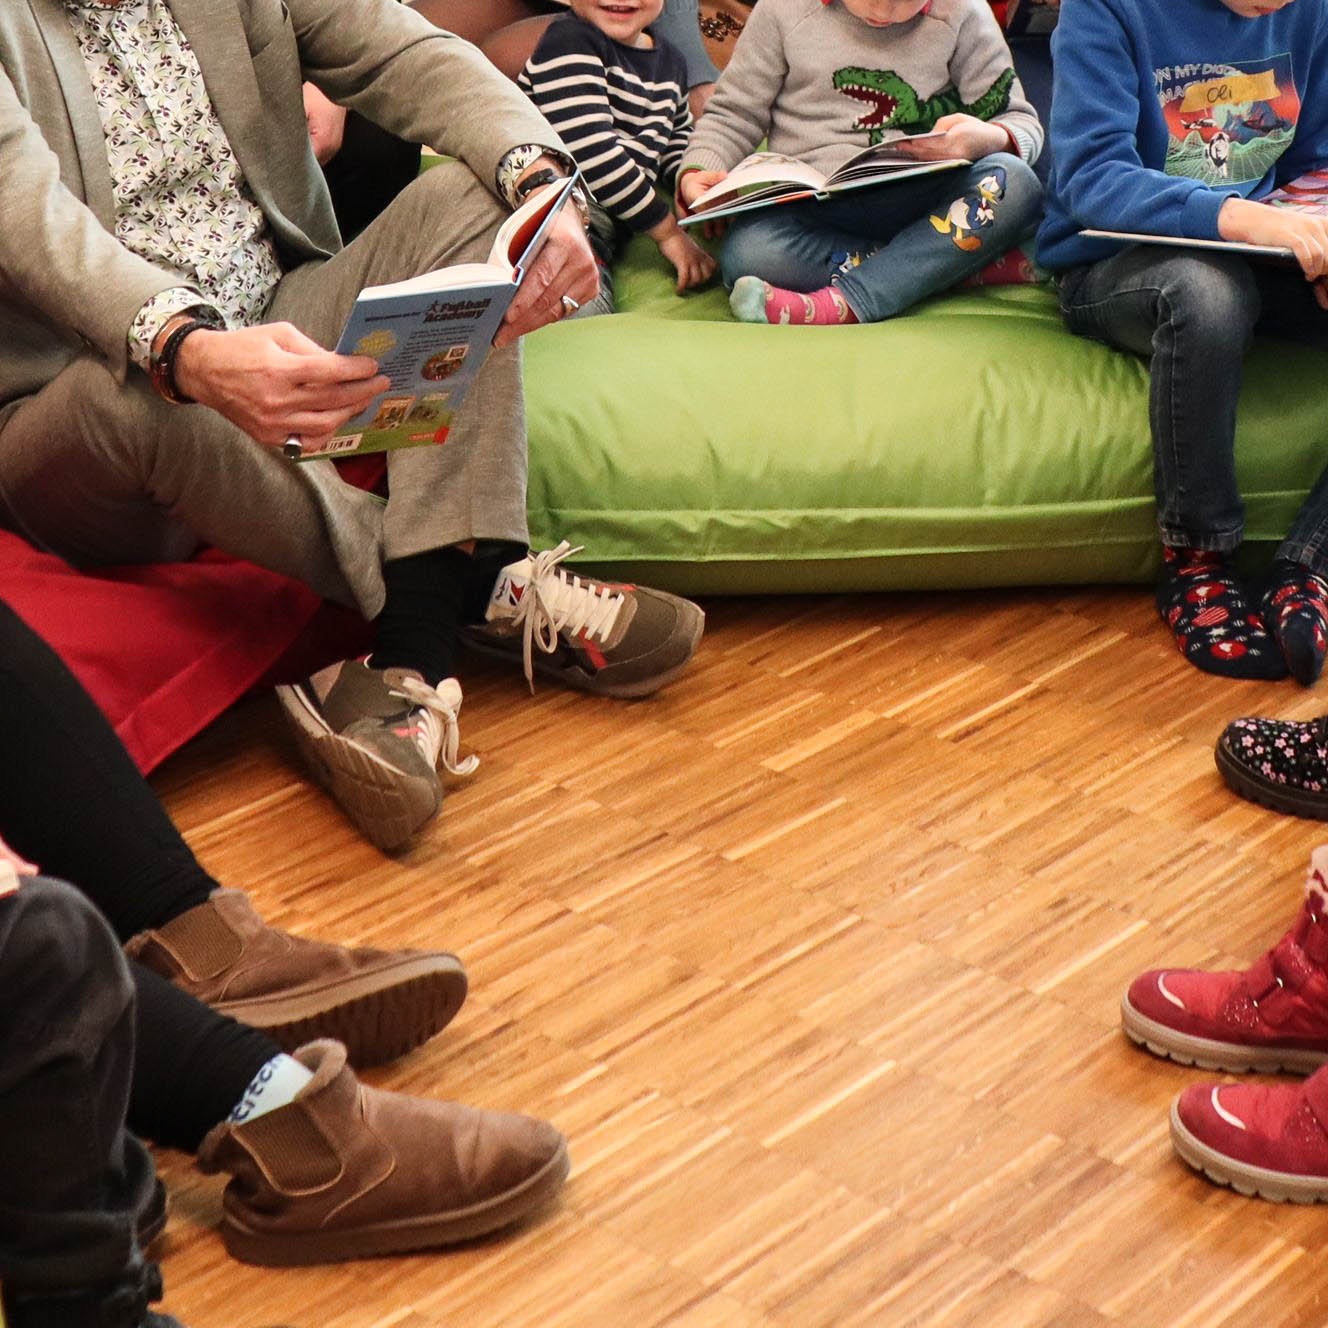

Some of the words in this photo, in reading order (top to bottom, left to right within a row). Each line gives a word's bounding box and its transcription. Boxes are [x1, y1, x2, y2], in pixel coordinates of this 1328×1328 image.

[1175, 64, 1200, 79] MY
[1207, 84, 1233, 104] Oli
[441, 298, 492, 313] Fußball
[423, 309, 485, 324] Academy
